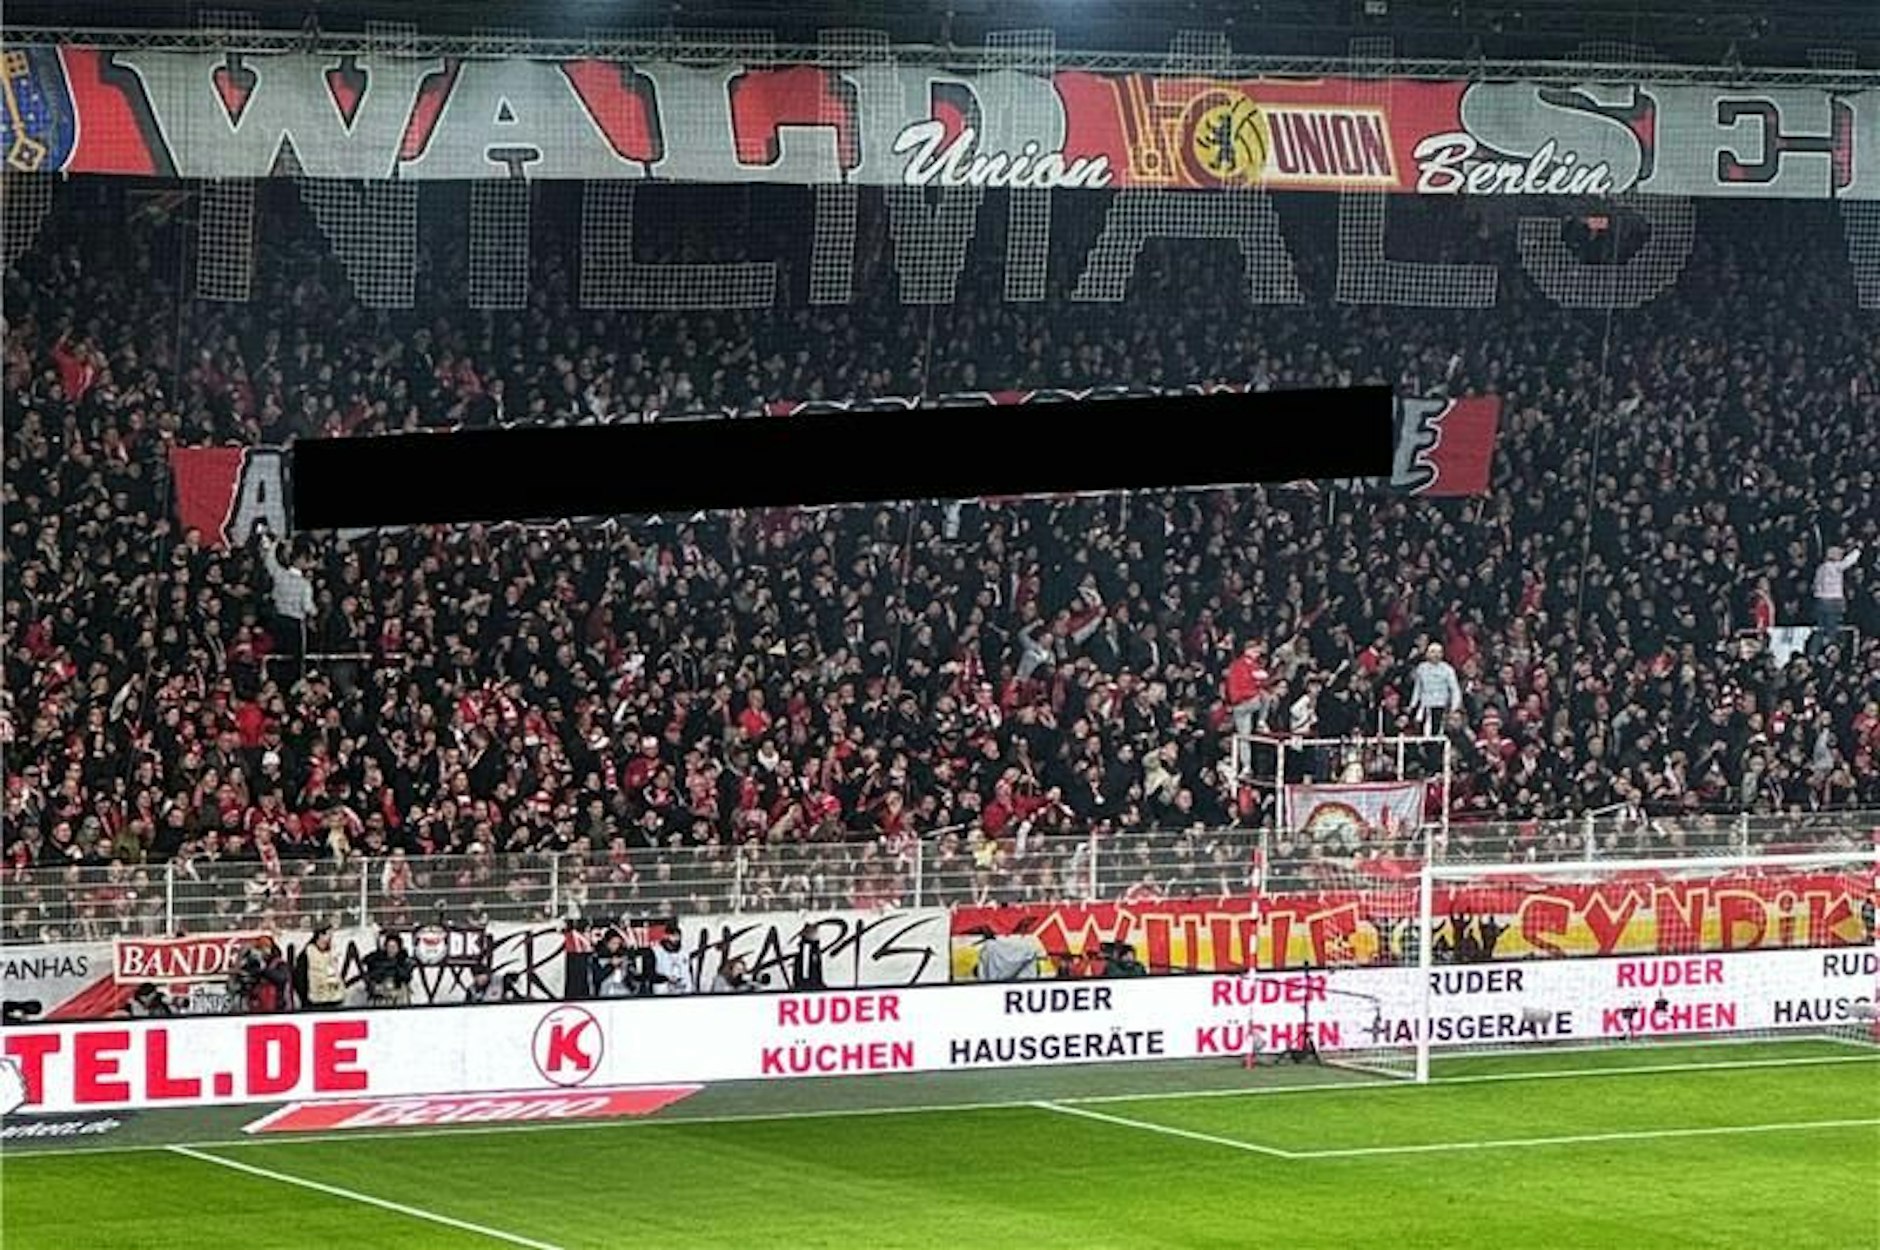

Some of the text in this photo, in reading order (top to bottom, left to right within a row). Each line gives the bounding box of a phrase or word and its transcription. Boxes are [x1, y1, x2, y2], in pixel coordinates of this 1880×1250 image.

[112, 52, 1068, 188] WALD
[893, 119, 1113, 187] Union
[1266, 112, 1392, 177] UNION
[1413, 132, 1613, 194] Berlin
[0, 955, 88, 980] ANHAS
[1428, 967, 1524, 996] RUDER
[1617, 958, 1724, 988] RUDER
[1004, 985, 1112, 1015] RUDER
[1211, 974, 1328, 1007] RUDER
[778, 994, 901, 1027] RUDER
[761, 1039, 915, 1076] KÜCHEN
[950, 1027, 1165, 1065] HAUSGERÄTE
